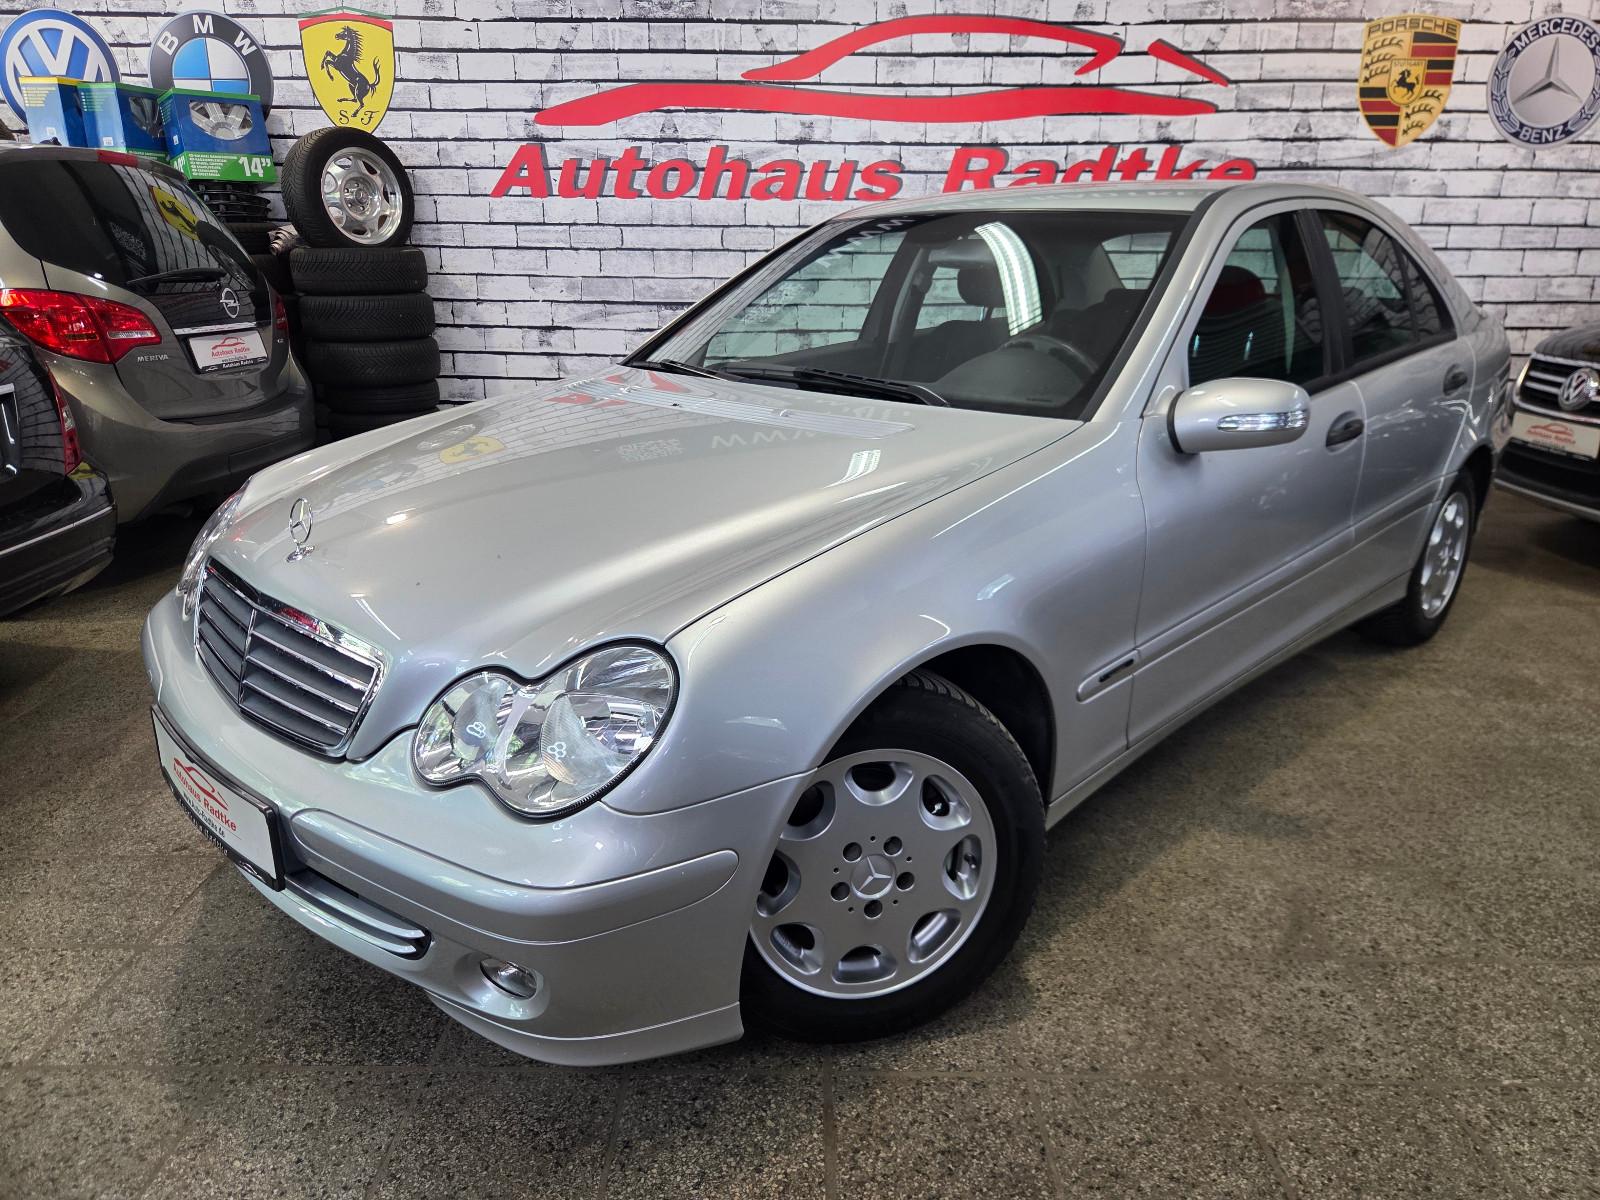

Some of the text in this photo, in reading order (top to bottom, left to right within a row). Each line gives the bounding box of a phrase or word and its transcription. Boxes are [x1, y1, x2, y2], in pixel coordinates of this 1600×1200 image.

[158, 15, 258, 56] BMW
[1367, 18, 1458, 39] PORSCHE
[1514, 18, 1599, 51] MERCEDES
[1519, 125, 1565, 143] BENZ
[490, 143, 1257, 201] Autohaus Radtke
[137, 354, 169, 363] MERIVA
[203, 797, 237, 831] Radtke
